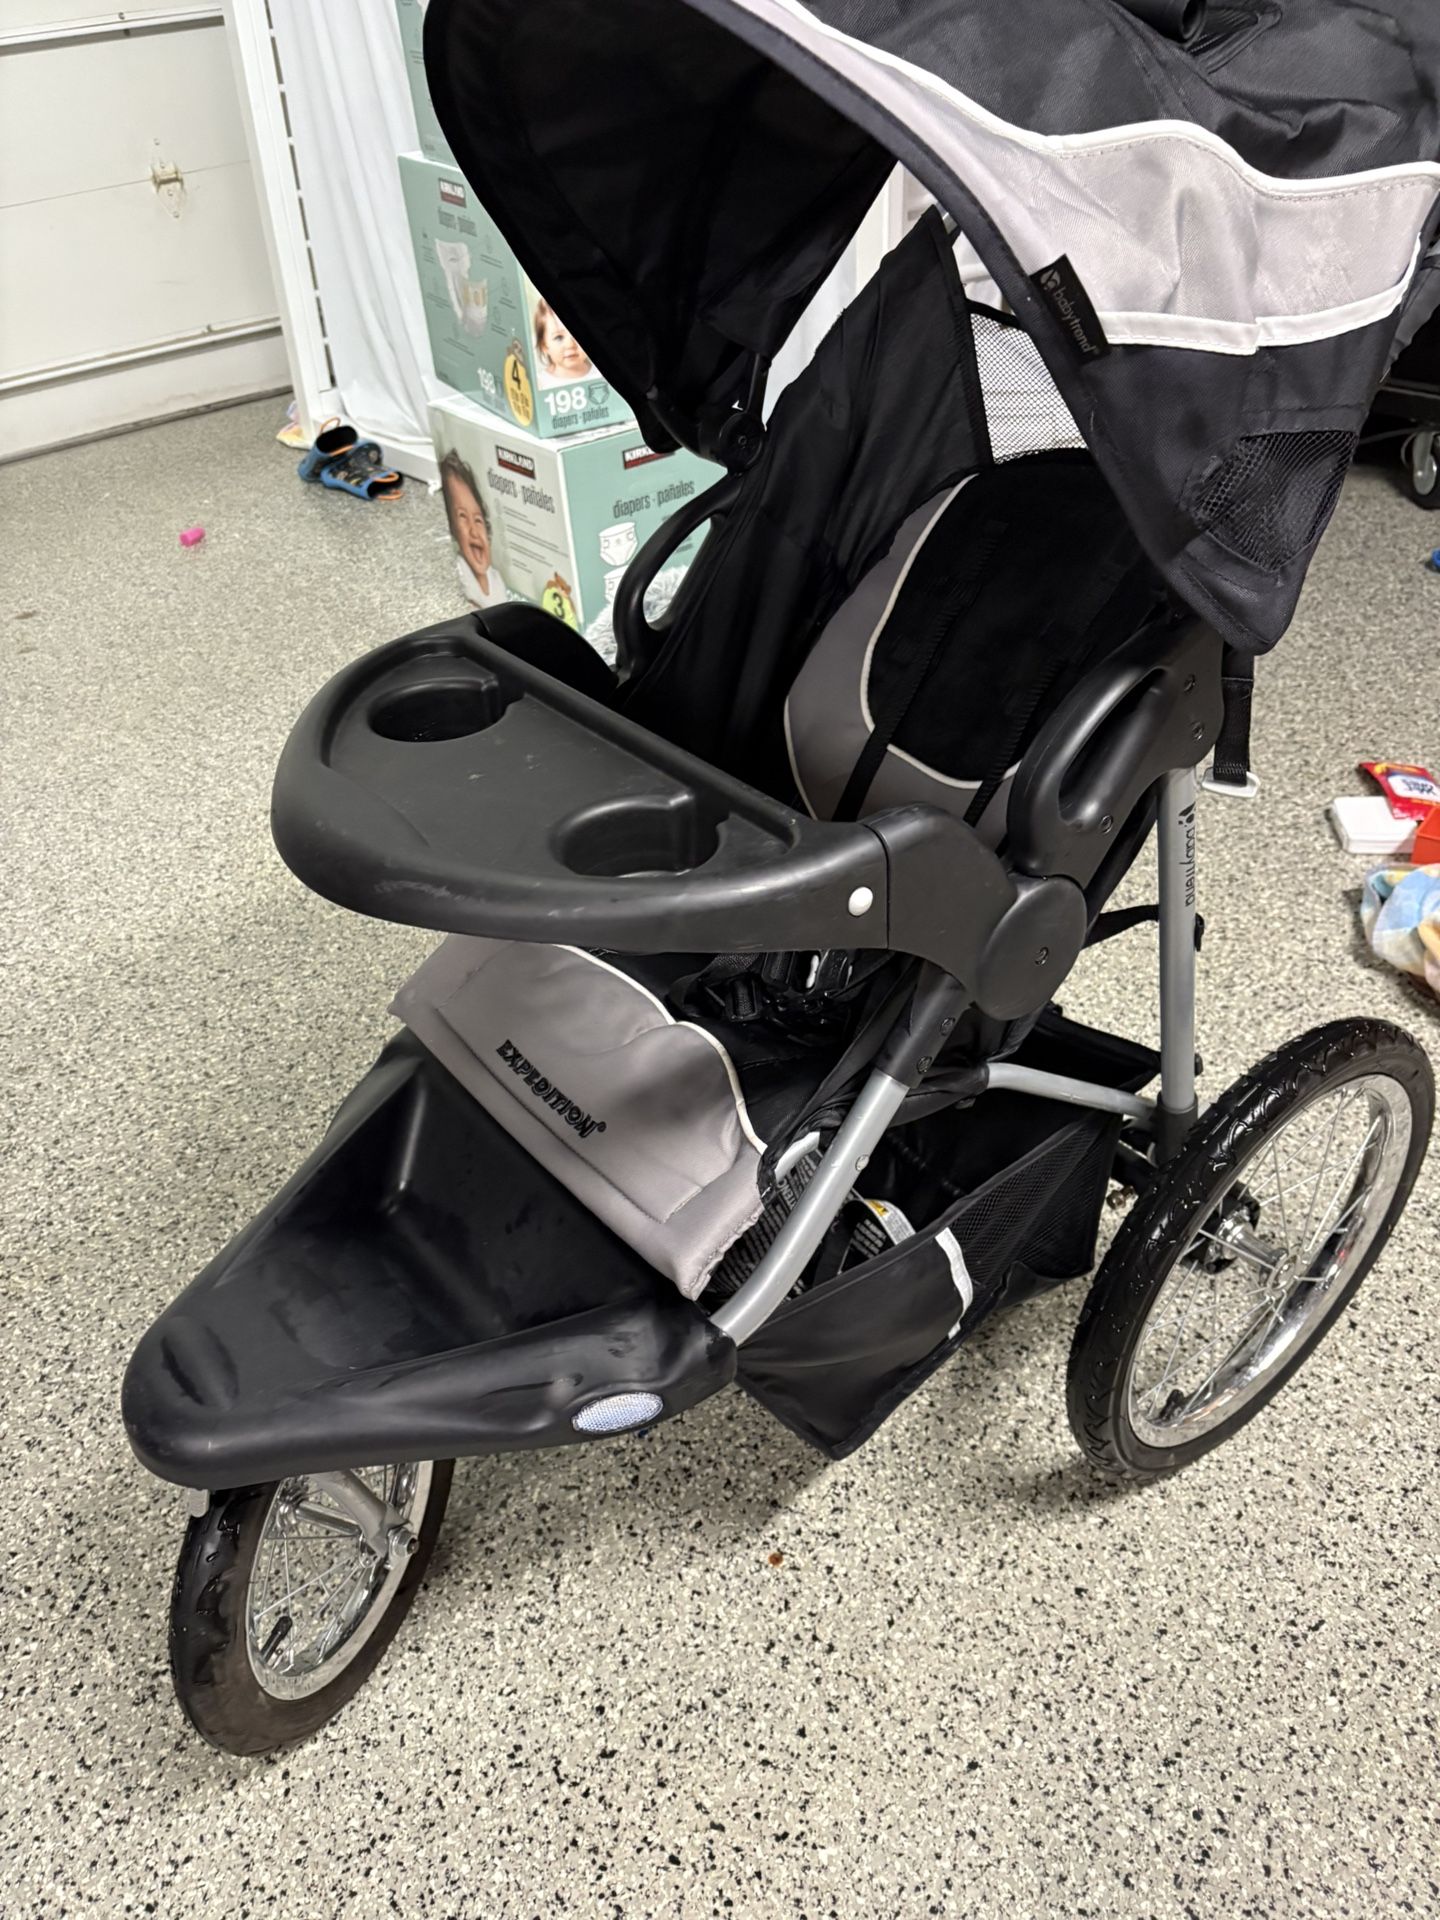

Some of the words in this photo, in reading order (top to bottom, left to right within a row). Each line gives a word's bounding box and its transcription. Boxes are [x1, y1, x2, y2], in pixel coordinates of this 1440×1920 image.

[512, 359, 521, 390] 4
[544, 386, 587, 416] 198
[613, 495, 650, 519] diapers
[657, 480, 695, 508] pañales
[552, 592, 565, 619] 3
